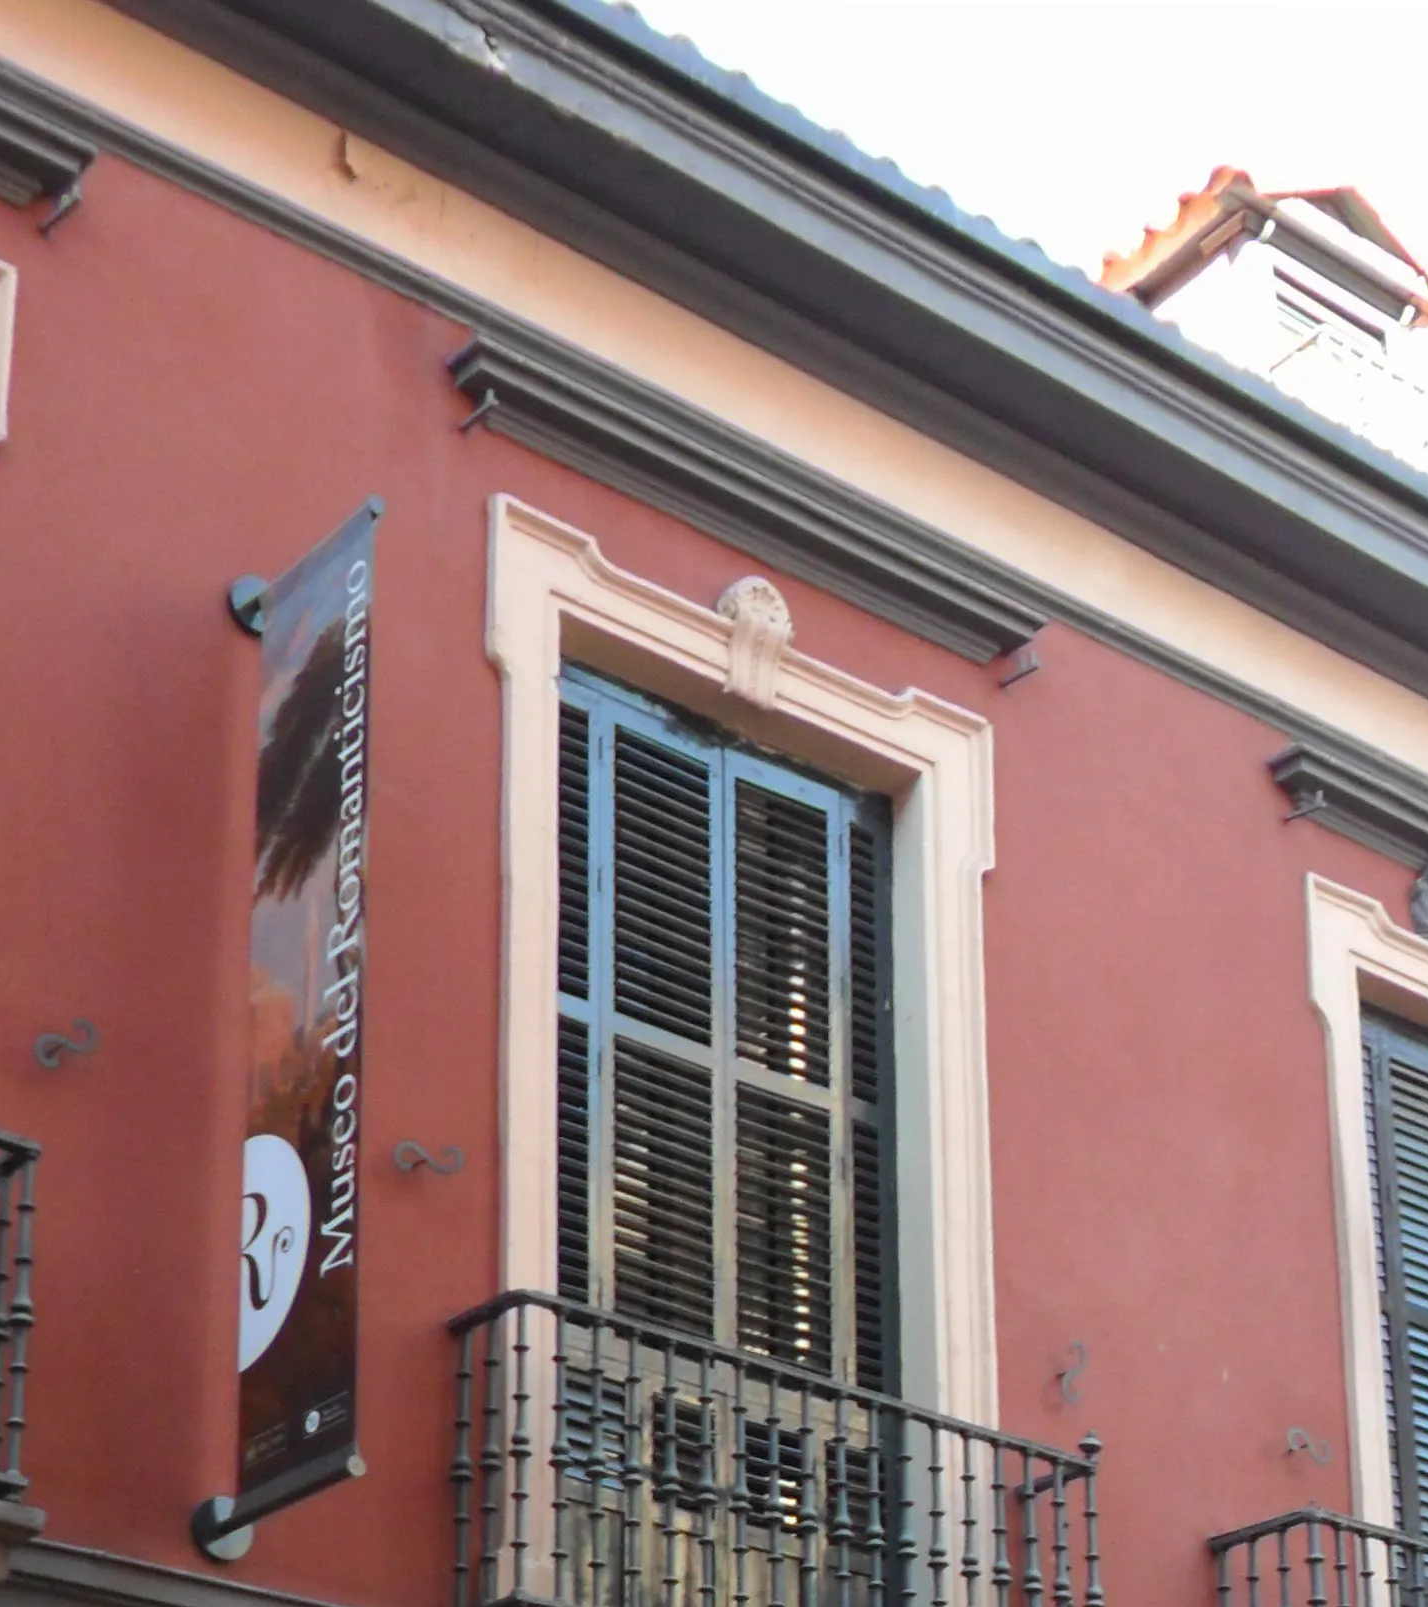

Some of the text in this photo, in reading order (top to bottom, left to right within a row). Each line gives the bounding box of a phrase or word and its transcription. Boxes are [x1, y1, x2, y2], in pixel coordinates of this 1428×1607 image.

[319, 559, 368, 1279] Museo del Romanticismo
